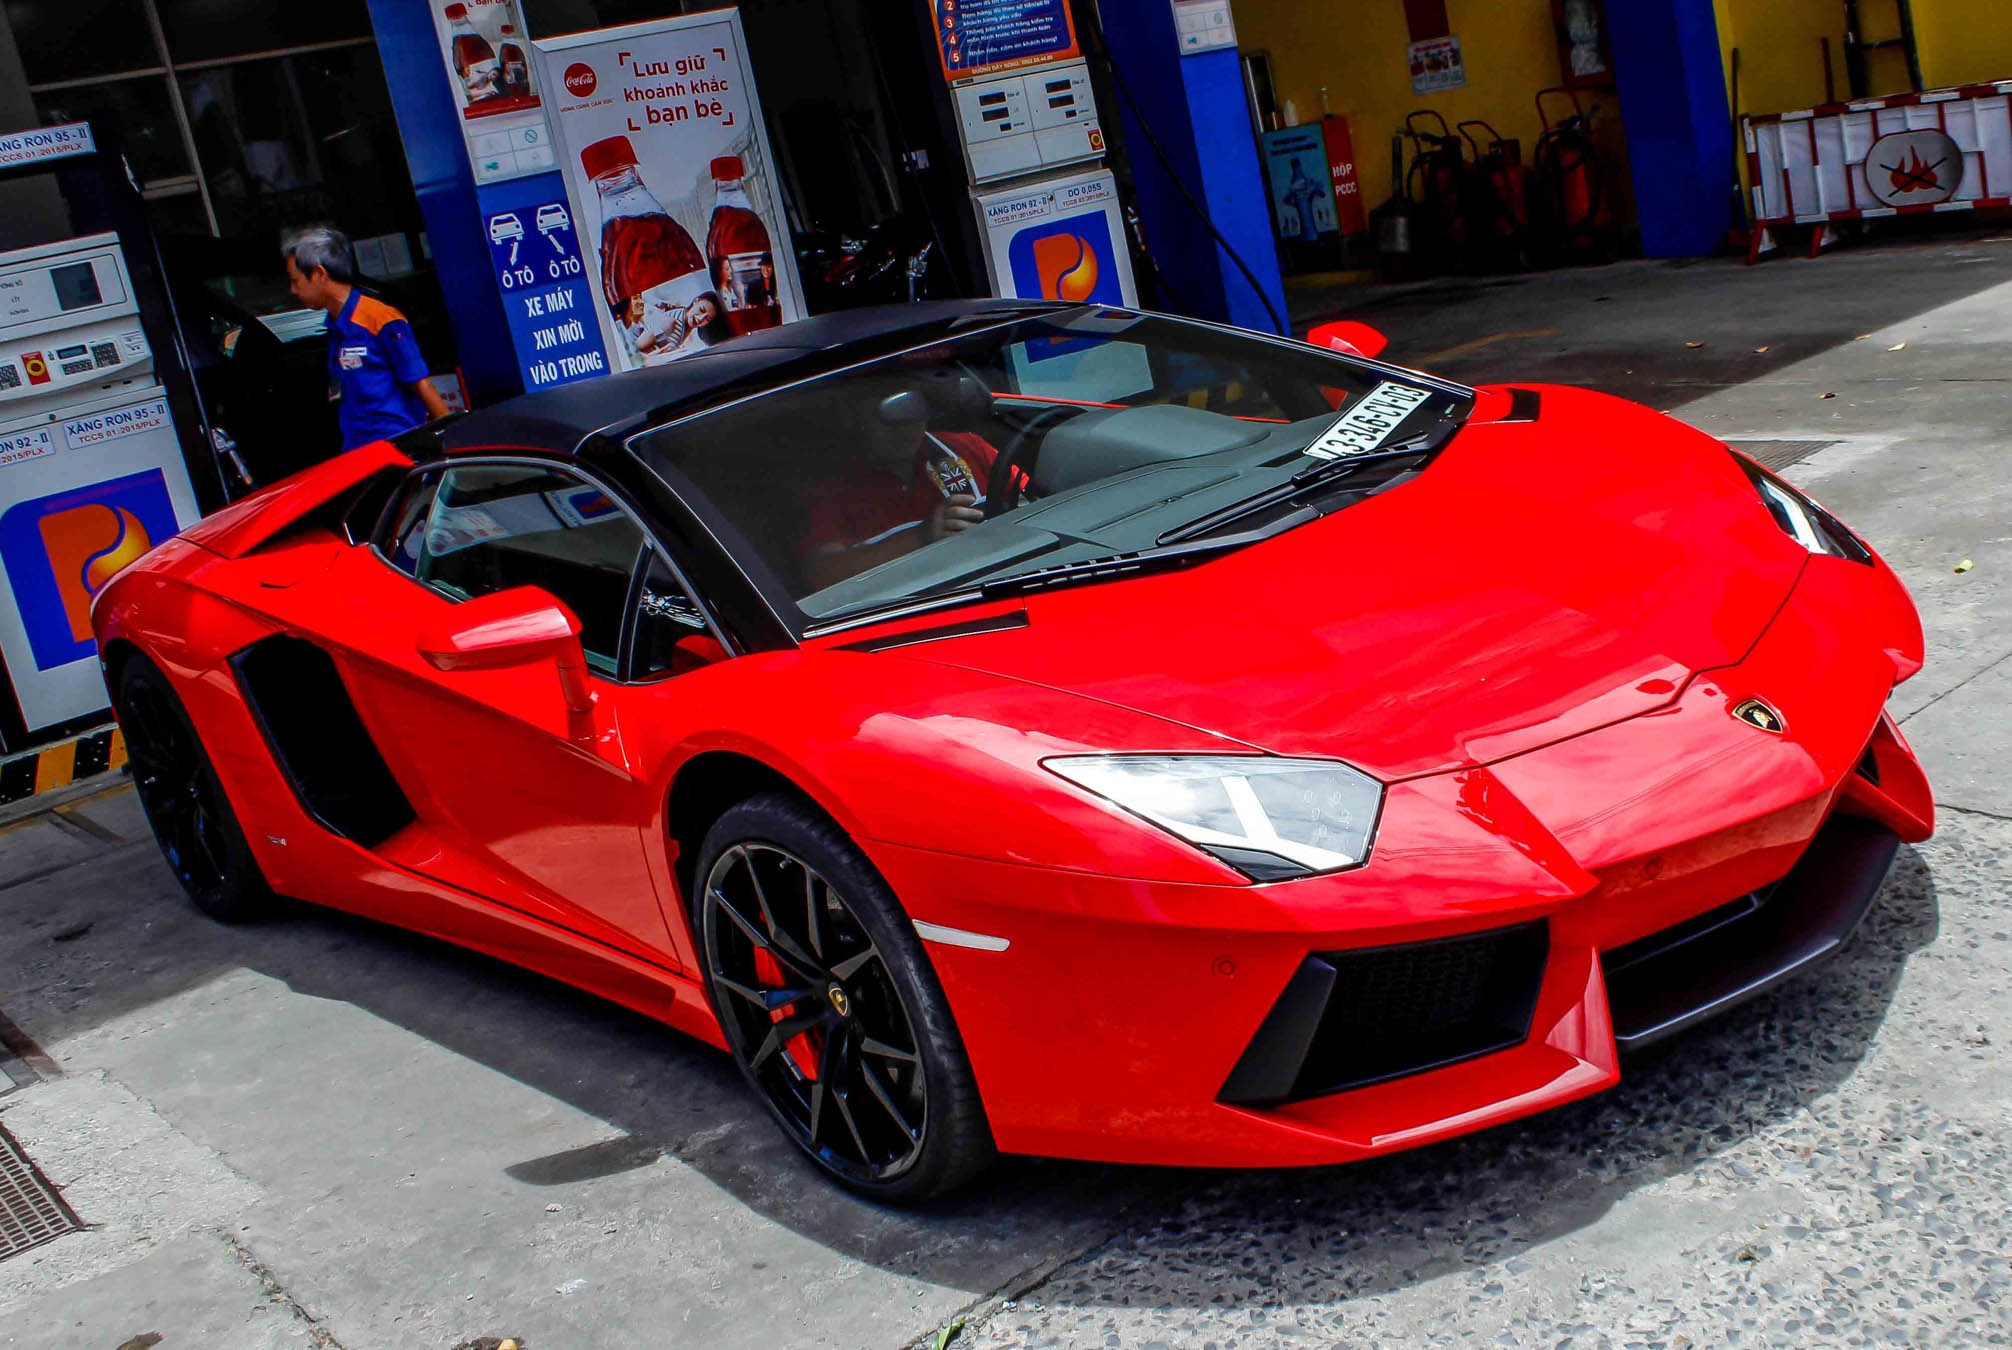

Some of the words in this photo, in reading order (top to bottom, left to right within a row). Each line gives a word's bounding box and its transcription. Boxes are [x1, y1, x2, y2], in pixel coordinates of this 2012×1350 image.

[947, 19, 952, 28] 3
[951, 35, 956, 45] 4
[633, 61, 669, 77] Lưu
[675, 54, 705, 75] giữ
[953, 53, 960, 62] 5
[624, 82, 686, 102] khoảnh
[690, 75, 728, 95] khắc
[646, 104, 689, 126] bạn
[694, 98, 723, 119] bè
[24, 134, 53, 148] RON
[55, 131, 70, 143] 95
[1068, 188, 1080, 197] DO
[1335, 182, 1357, 197] PCCC
[1010, 201, 1028, 212] RON
[1029, 199, 1038, 208] 92
[549, 259, 560, 278] Ô
[561, 255, 580, 275] TÔ
[502, 270, 513, 288] Ô
[515, 265, 534, 286] TÔ
[525, 296, 544, 317] XE
[545, 287, 574, 313] MÁY
[533, 328, 557, 350] XIN
[558, 319, 585, 344] MỜI
[530, 360, 557, 385] VÀO
[558, 351, 603, 378] TRONG
[106, 412, 133, 426] RON
[134, 409, 149, 420] 95
[17, 437, 31, 448] 92
[79, 432, 104, 443] TCCS
